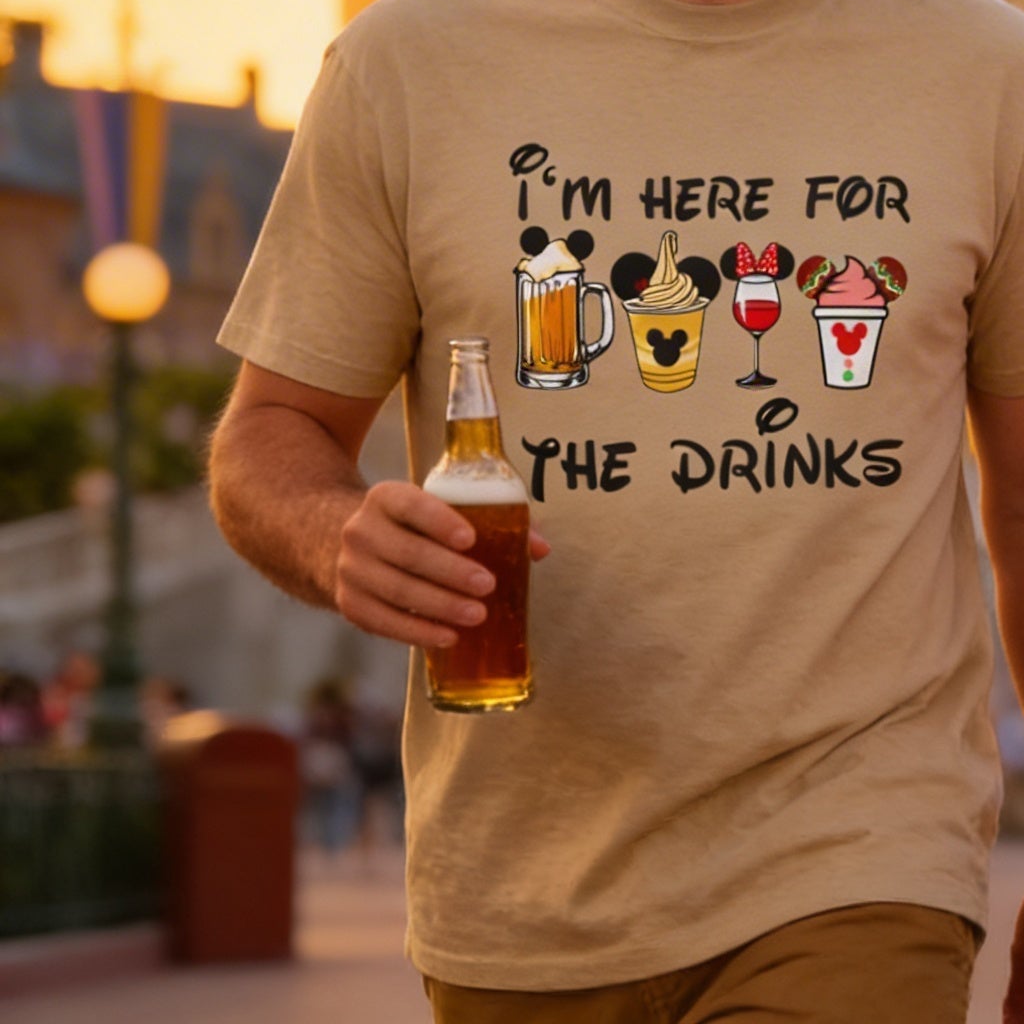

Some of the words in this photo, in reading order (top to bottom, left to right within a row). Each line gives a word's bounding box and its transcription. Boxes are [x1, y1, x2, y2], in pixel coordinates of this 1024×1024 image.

[639, 175, 774, 222] HERE
[805, 175, 911, 224] FOR
[521, 436, 637, 503] THE
[670, 397, 904, 494] DRINKS
